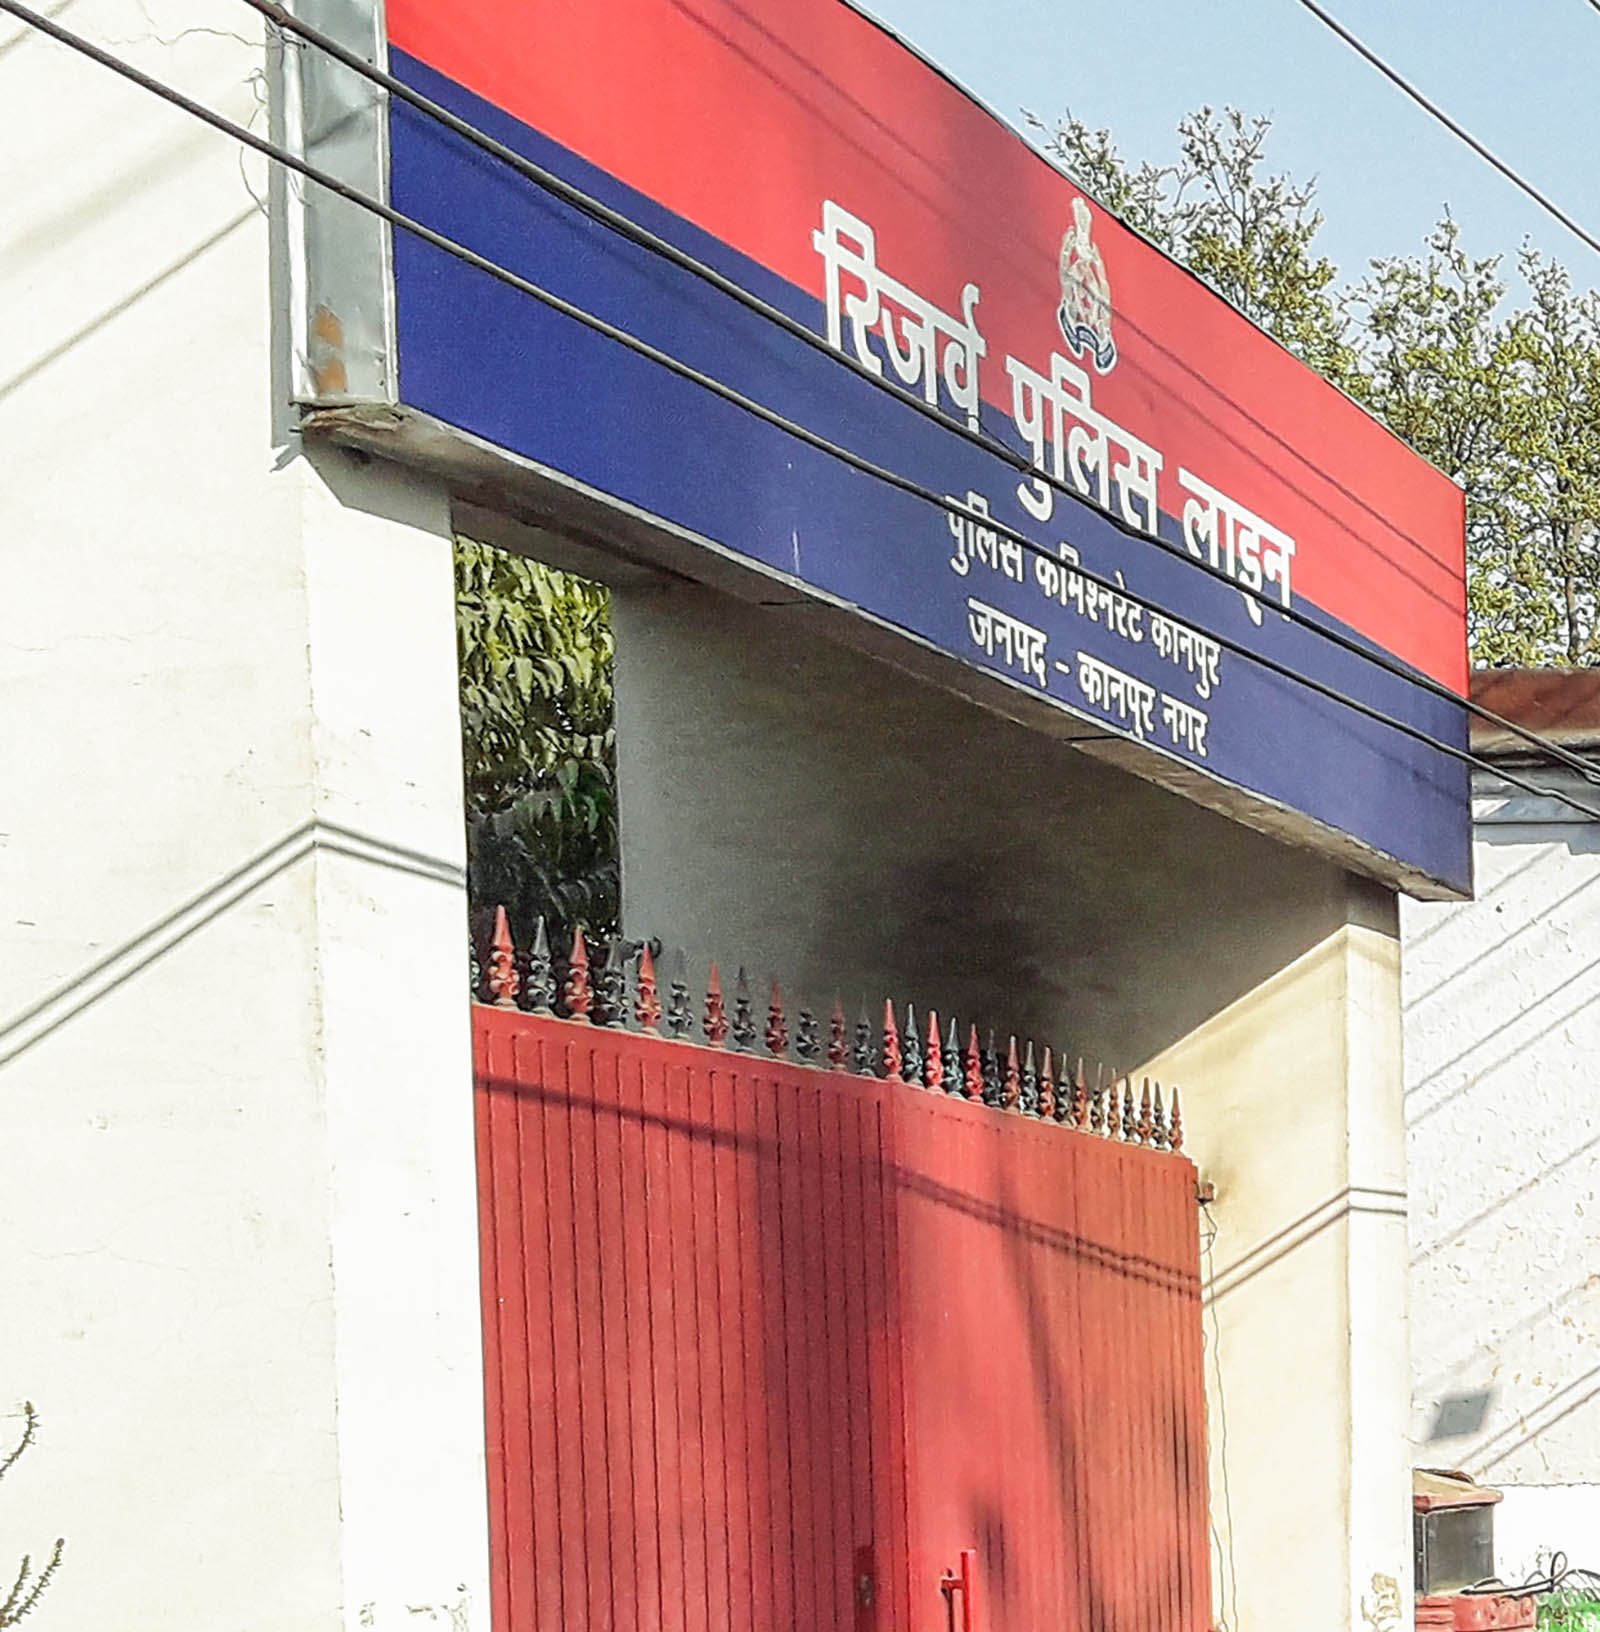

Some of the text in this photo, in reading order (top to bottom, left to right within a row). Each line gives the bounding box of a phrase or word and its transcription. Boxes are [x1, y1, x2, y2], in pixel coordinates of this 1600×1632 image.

[812, 199, 1296, 627] रिजर्व पुलिस लाइन
[945, 490, 1220, 700] पुलिस कमिश्नरेट कानपुर
[968, 597, 1047, 688] जनपद
[1077, 650, 1156, 740] कानपुर
[1161, 692, 1209, 758] नगर
